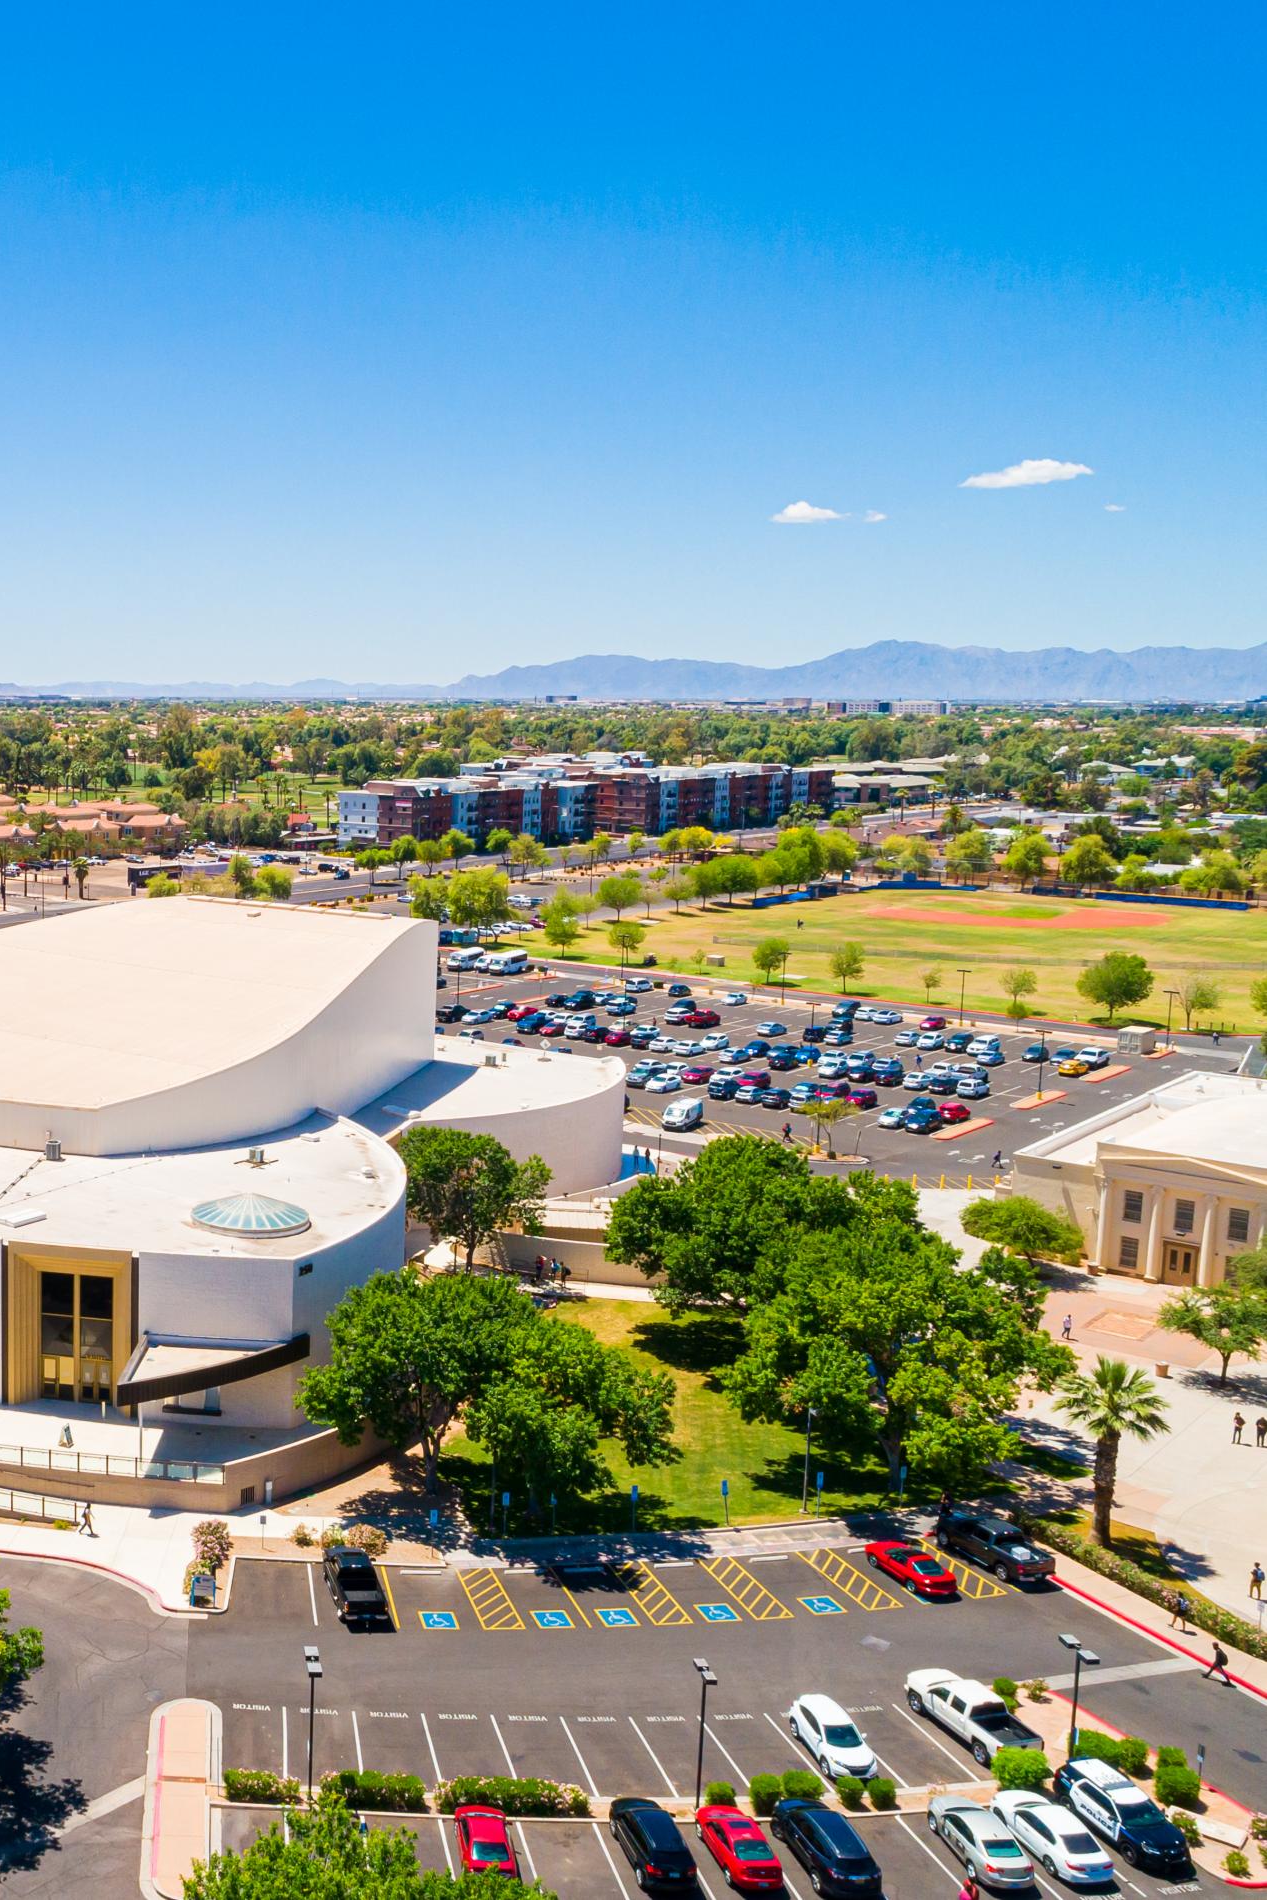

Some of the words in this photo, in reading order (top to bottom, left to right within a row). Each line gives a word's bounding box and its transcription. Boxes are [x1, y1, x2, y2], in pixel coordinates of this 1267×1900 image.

[233, 1703, 271, 1712] VISITOR
[369, 1711, 409, 1719] VISITOR
[1079, 1803, 1114, 1832] POLICE
